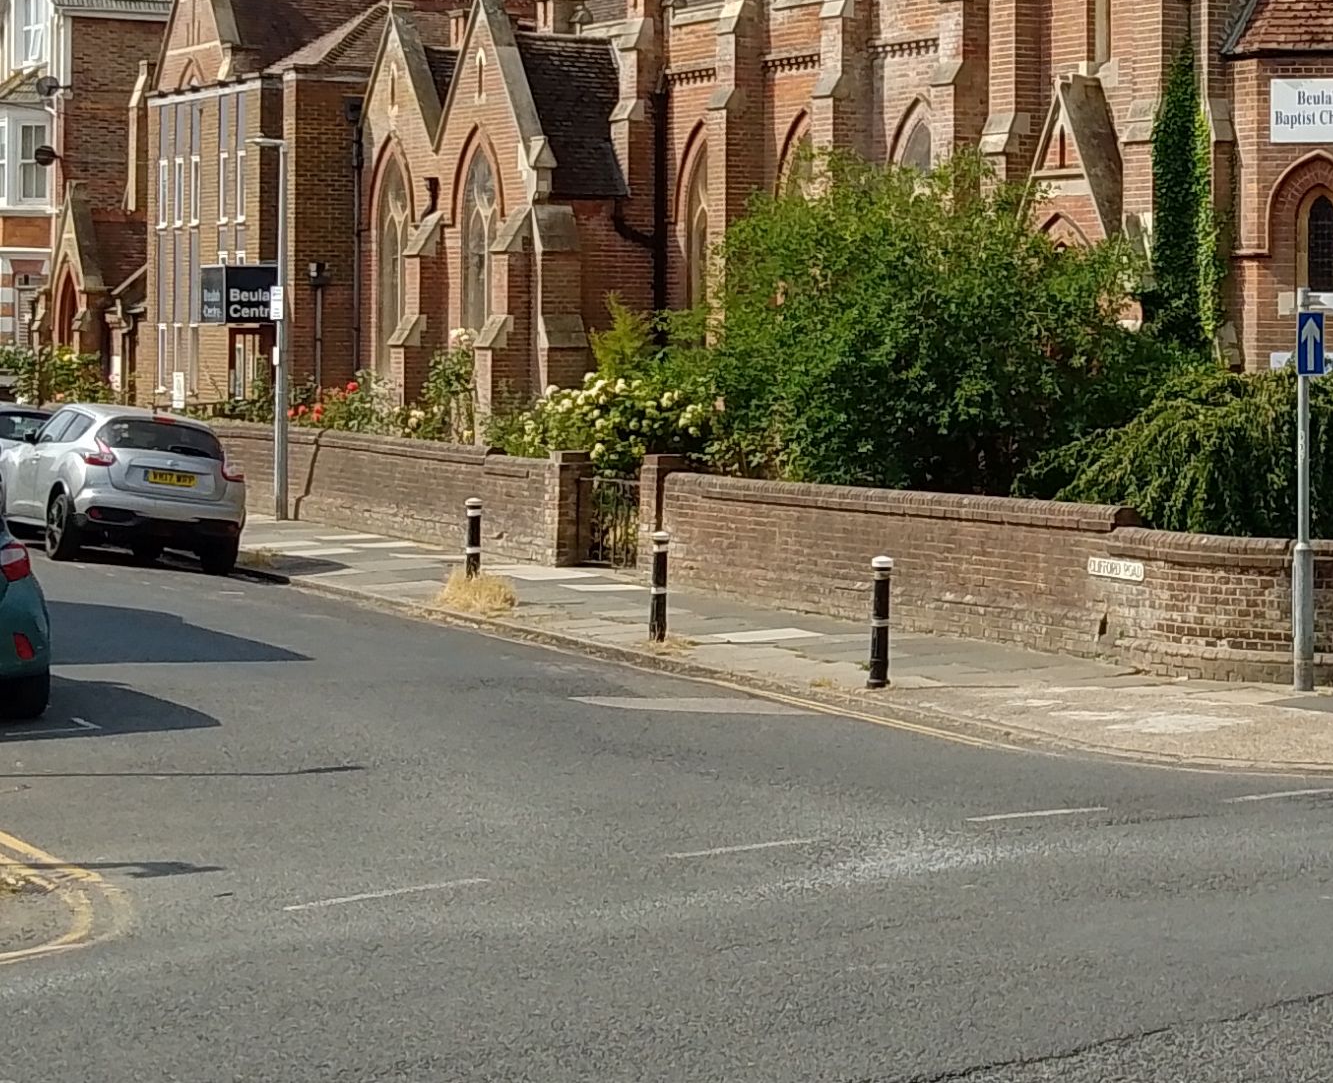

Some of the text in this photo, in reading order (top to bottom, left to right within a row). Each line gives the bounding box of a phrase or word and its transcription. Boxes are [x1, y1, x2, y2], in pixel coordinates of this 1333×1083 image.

[1275, 110, 1316, 129] Baptist
[229, 288, 270, 302] Beula
[229, 304, 270, 318] Centr
